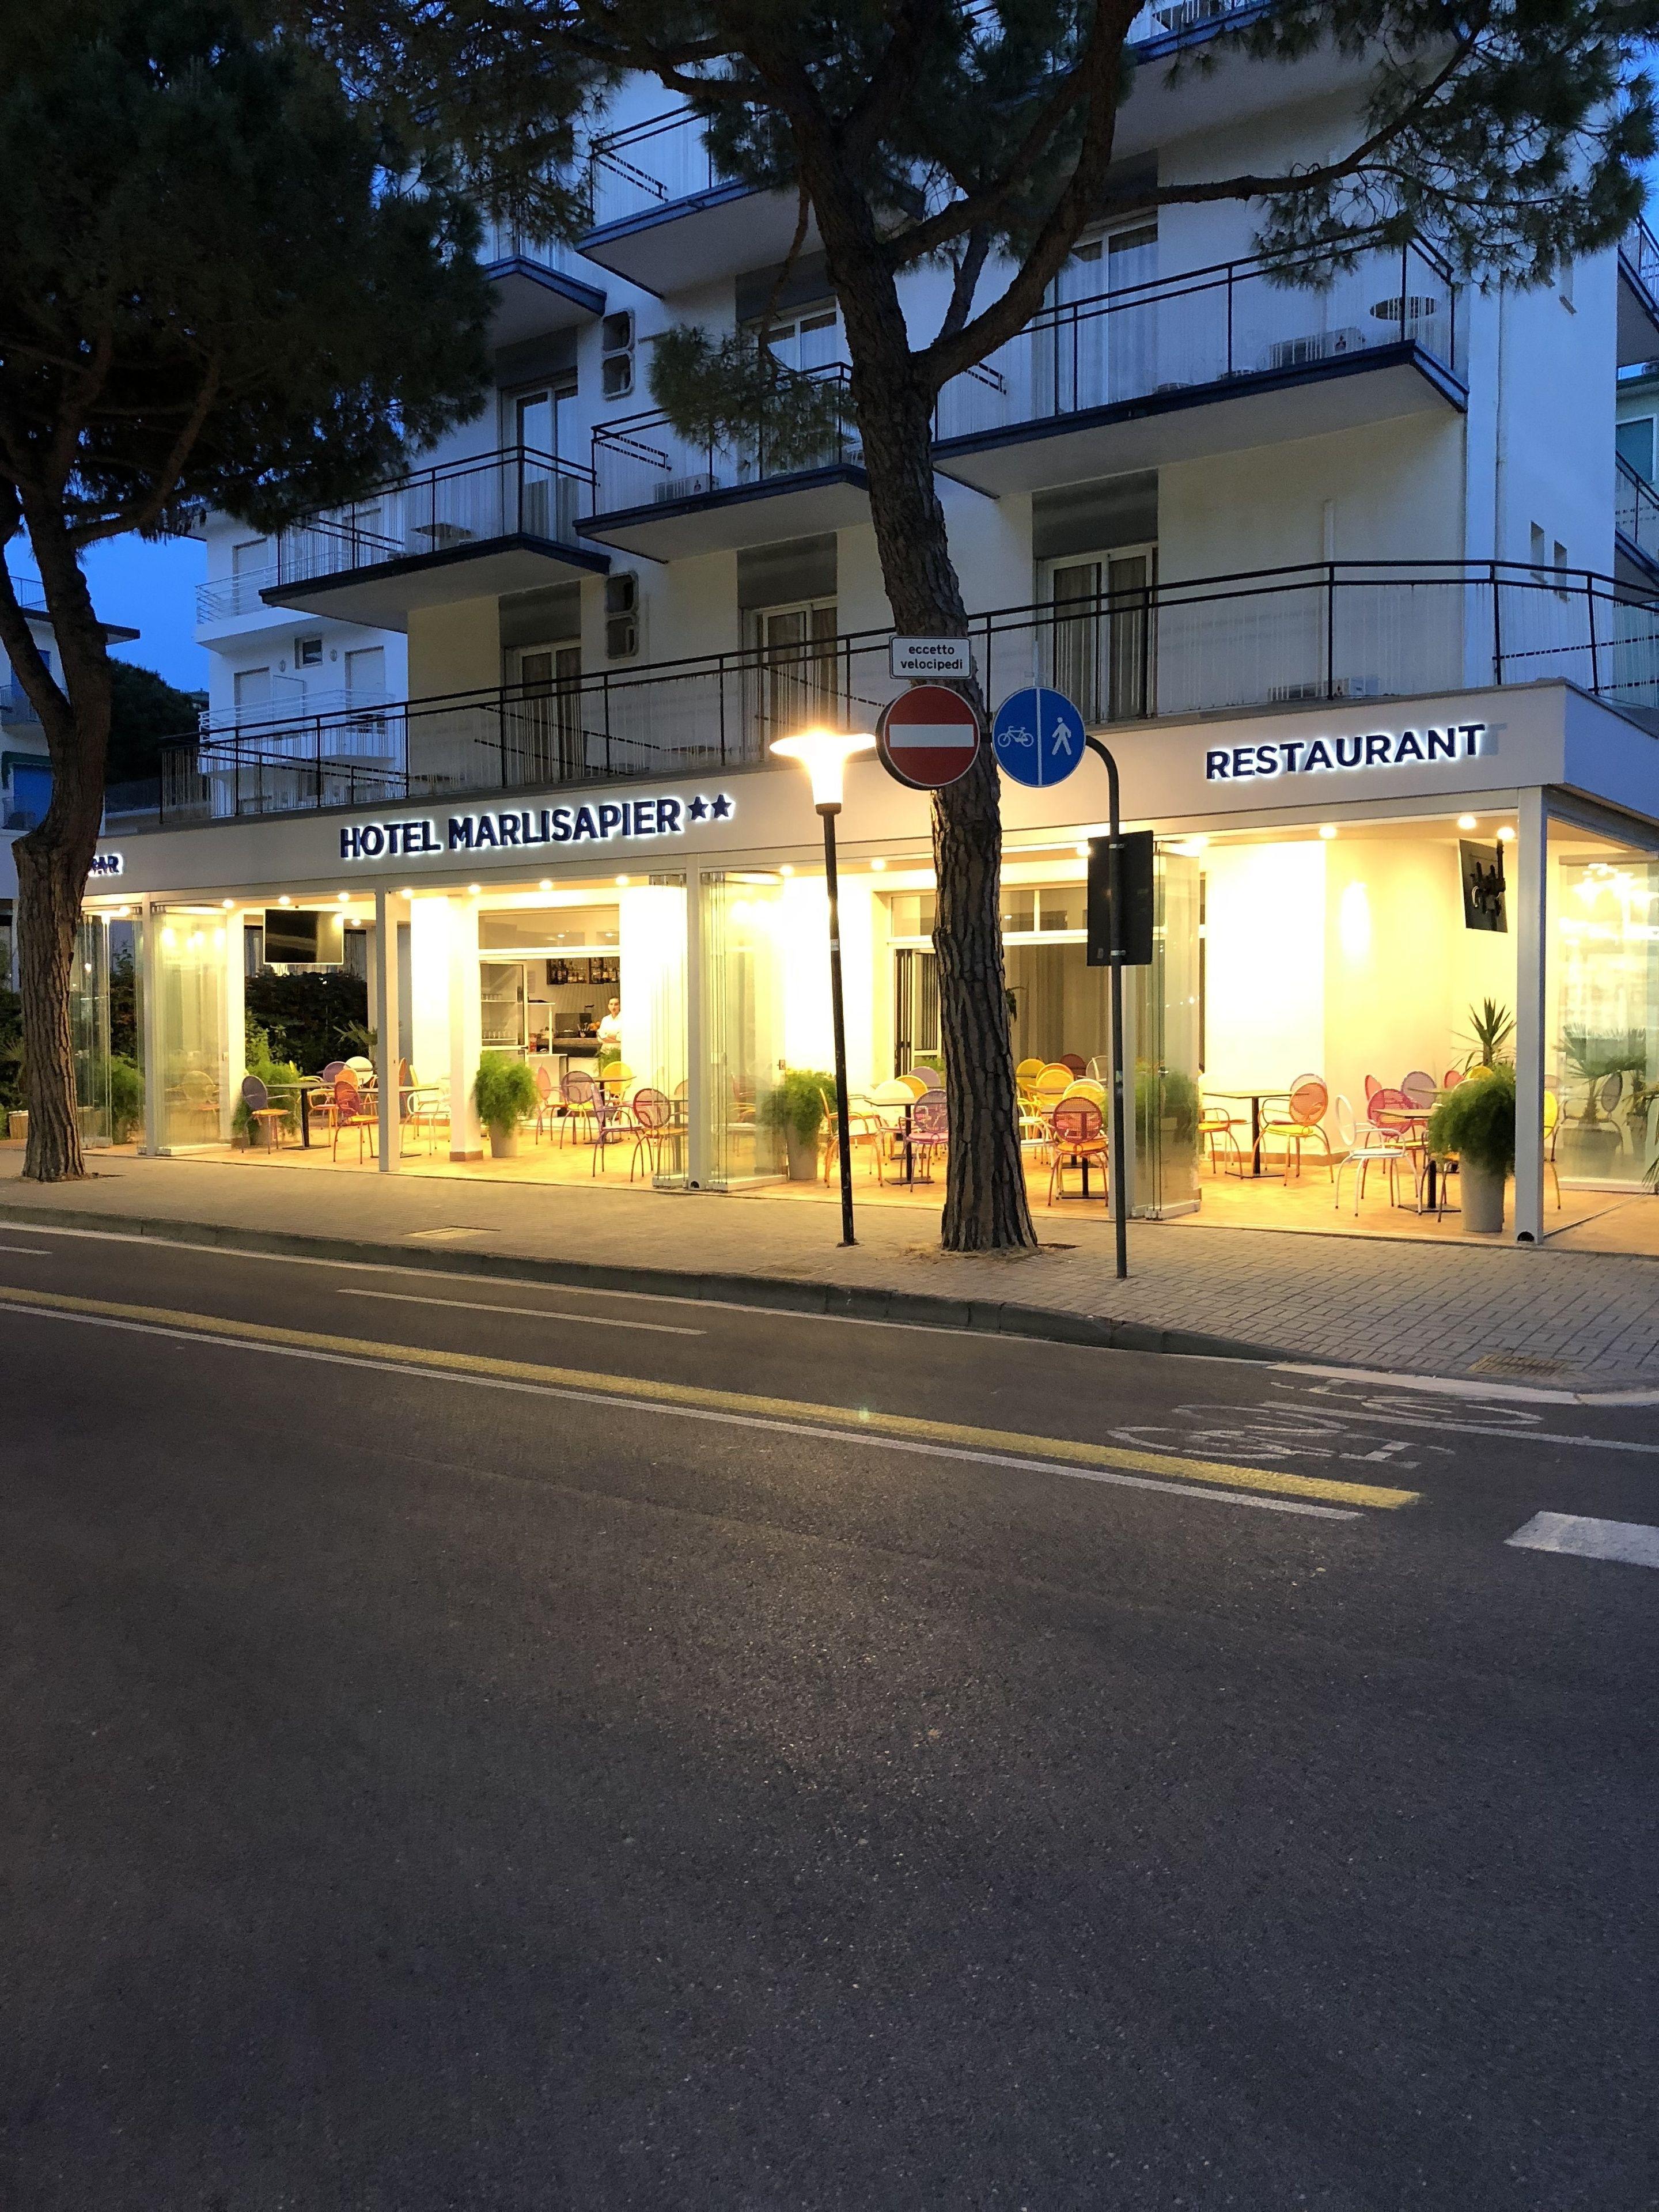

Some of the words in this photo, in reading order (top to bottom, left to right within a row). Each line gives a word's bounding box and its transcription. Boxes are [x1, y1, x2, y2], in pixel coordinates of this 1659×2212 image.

[901, 658, 963, 671] velocipedi
[908, 644, 955, 655] eccetto
[1206, 724, 1486, 779] RESTAURANT
[340, 821, 441, 858] HOTEL
[448, 798, 682, 849] MARLISAPIER
